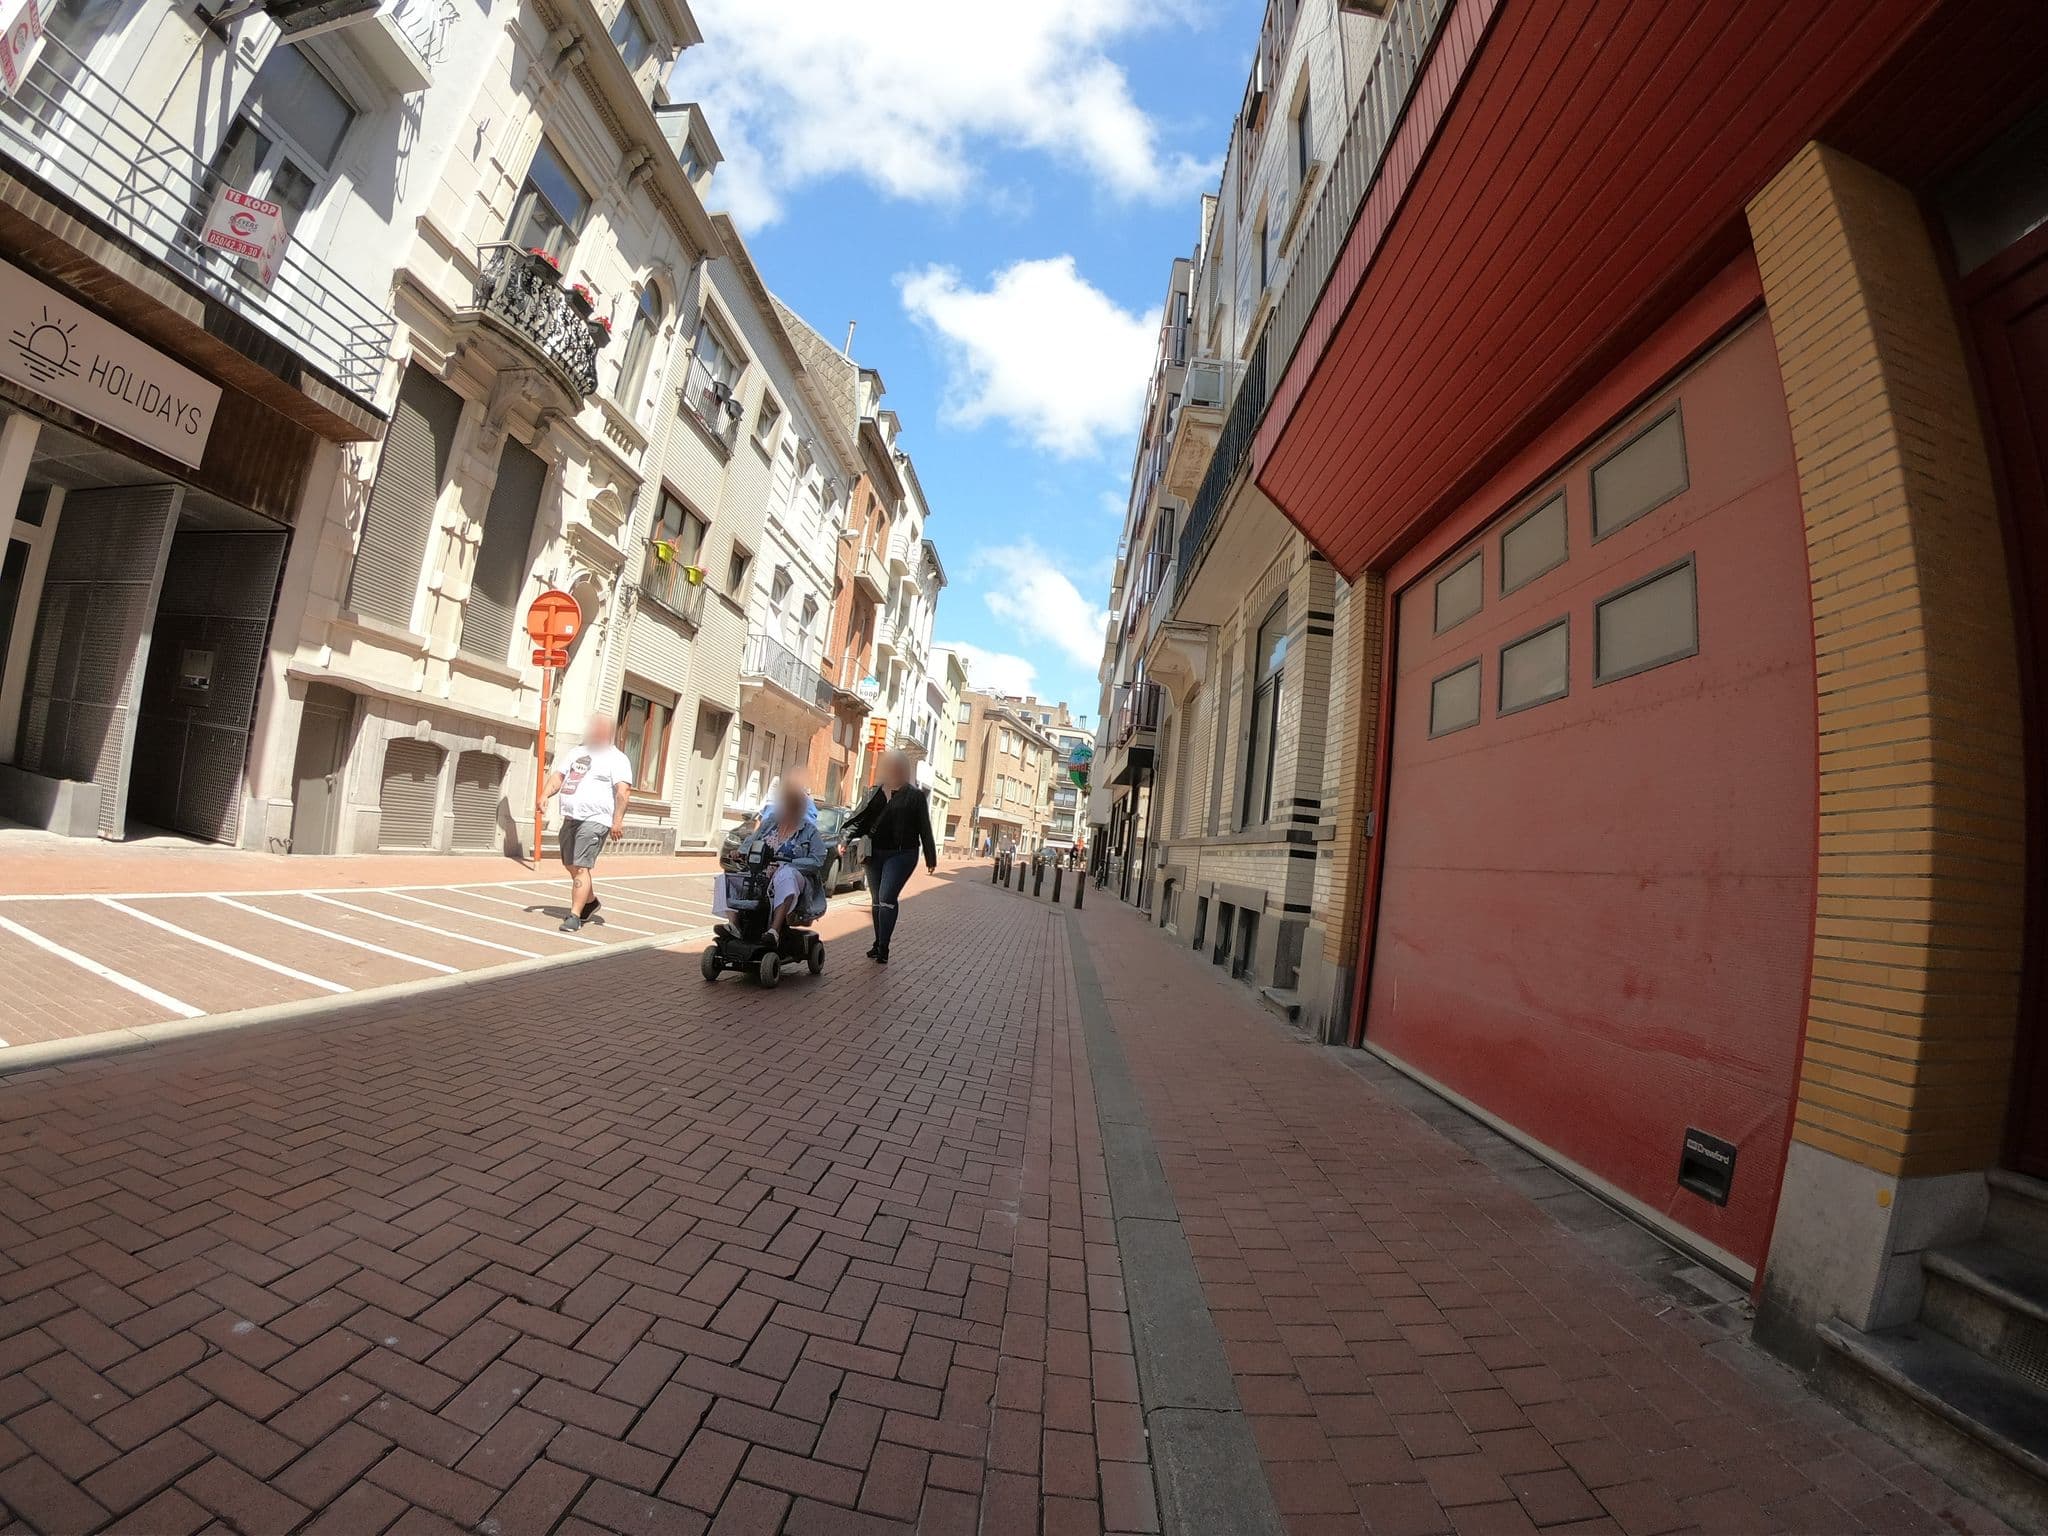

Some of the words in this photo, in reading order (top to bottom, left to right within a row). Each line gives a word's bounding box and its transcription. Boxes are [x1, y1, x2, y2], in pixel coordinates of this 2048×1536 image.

[228, 190, 242, 205] TE
[244, 197, 277, 215] KOOP
[88, 354, 202, 435] HOLIDAYS
